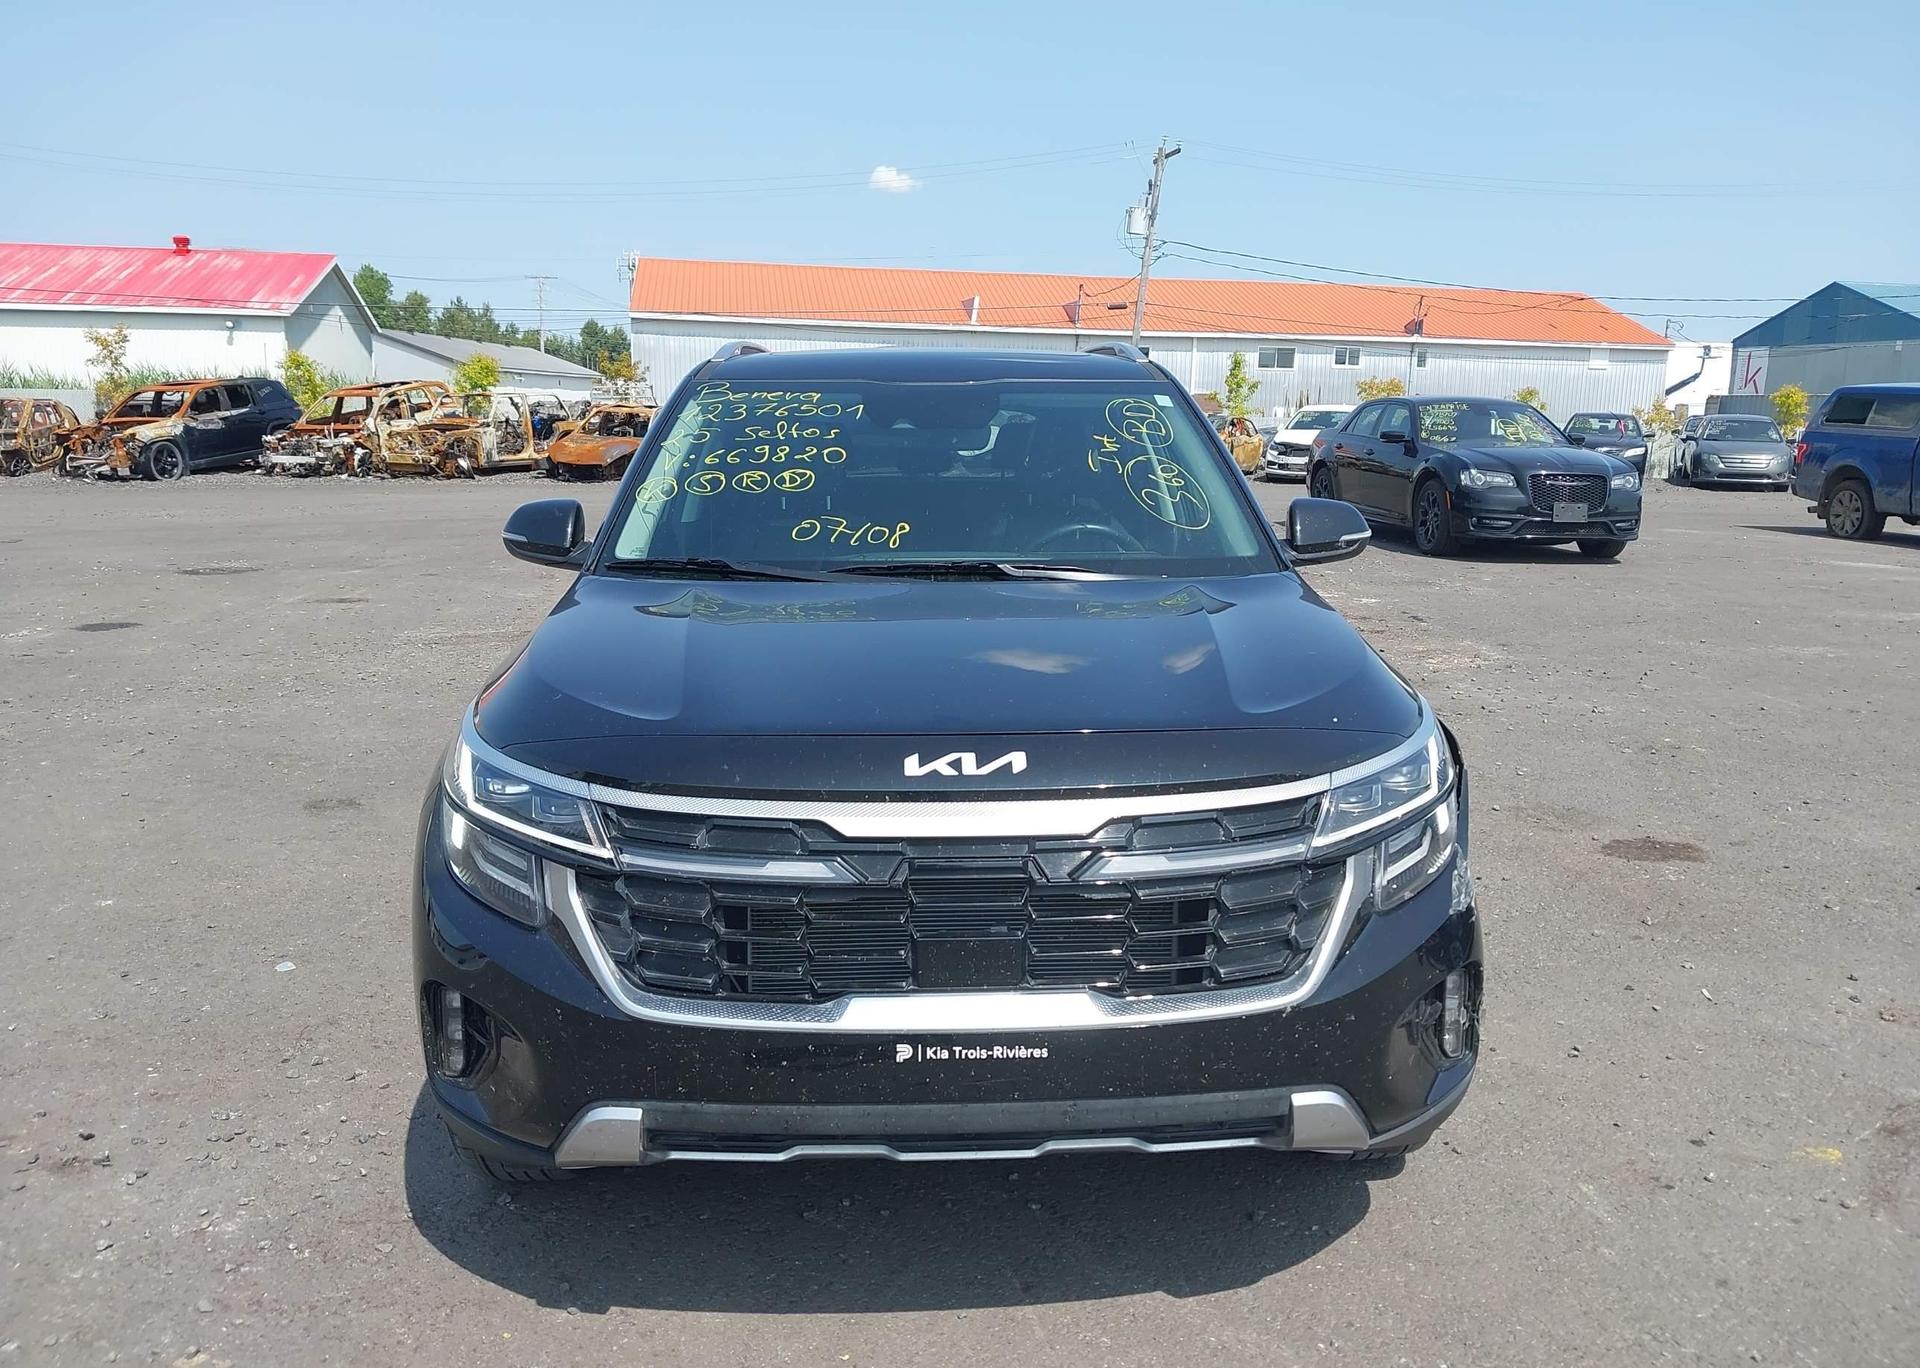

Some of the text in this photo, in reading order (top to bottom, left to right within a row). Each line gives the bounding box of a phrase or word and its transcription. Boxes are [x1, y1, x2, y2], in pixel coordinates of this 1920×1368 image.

[904, 751, 1028, 777] KIA
[926, 1046, 949, 1060] Kia
[953, 1045, 1049, 1060] Trois-Rivières
